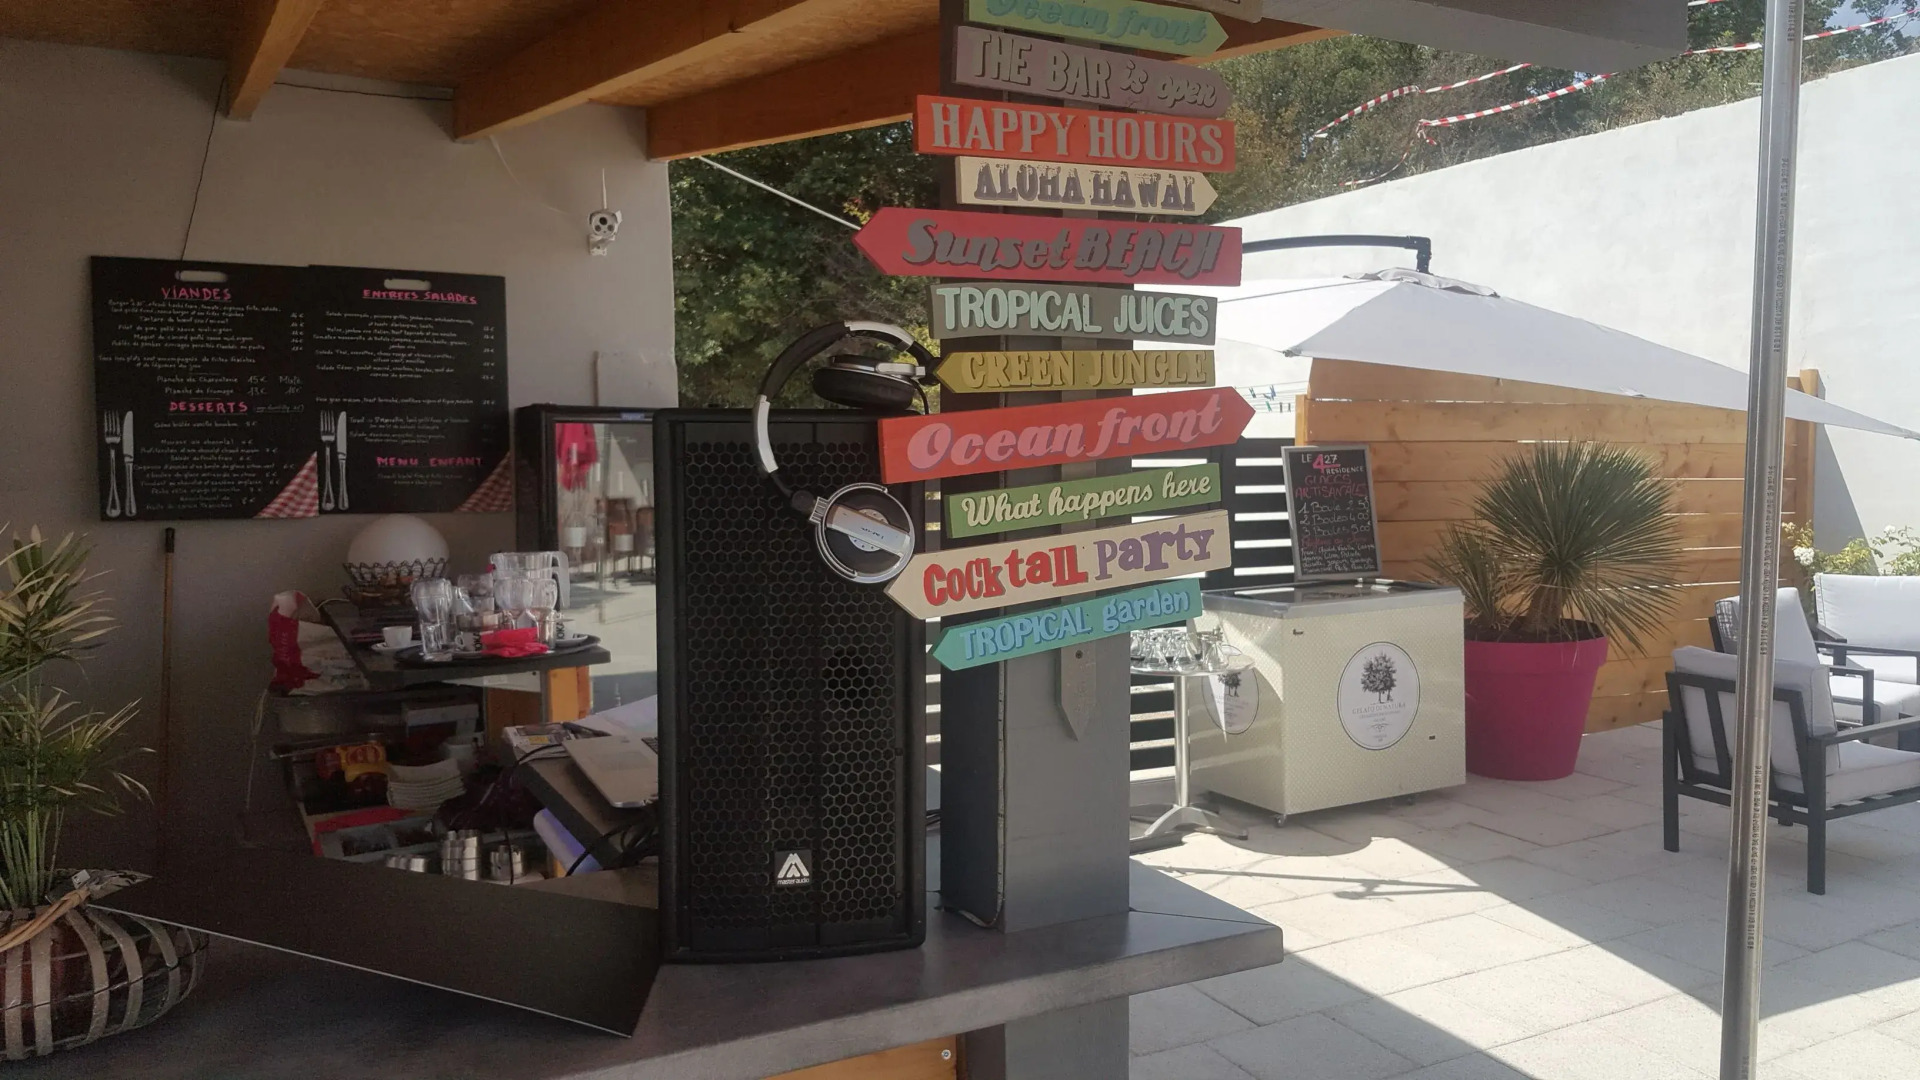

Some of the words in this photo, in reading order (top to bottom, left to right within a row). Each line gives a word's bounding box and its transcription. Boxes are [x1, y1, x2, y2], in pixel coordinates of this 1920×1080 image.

[1109, 7, 1207, 45] front
[973, 31, 1032, 87] THE
[1046, 50, 1112, 99] BAR
[1120, 59, 1149, 95] is
[1157, 75, 1218, 108] open
[930, 102, 1075, 156] HAPPY
[1088, 115, 1223, 165] HOURS
[973, 160, 1085, 205] ALOHA
[1089, 169, 1196, 211] HAWAI
[901, 218, 1072, 272] Sunset
[1073, 228, 1225, 278] BEACH
[424, 291, 478, 305] SALADES
[936, 286, 1102, 334] TROPICAL
[1113, 289, 1209, 338] JUICES
[1087, 349, 1208, 387] JUNGLE
[169, 402, 248, 413] DESSERTS
[906, 420, 1087, 470] Ocean
[1085, 394, 1224, 459] front
[376, 456, 419, 467] MENU
[1301, 453, 1312, 463] LE
[960, 495, 1043, 527] What
[1047, 483, 1153, 521] happens
[1161, 470, 1212, 498] here
[959, 606, 1093, 660] TROPICAL
[1102, 589, 1191, 632] garden
